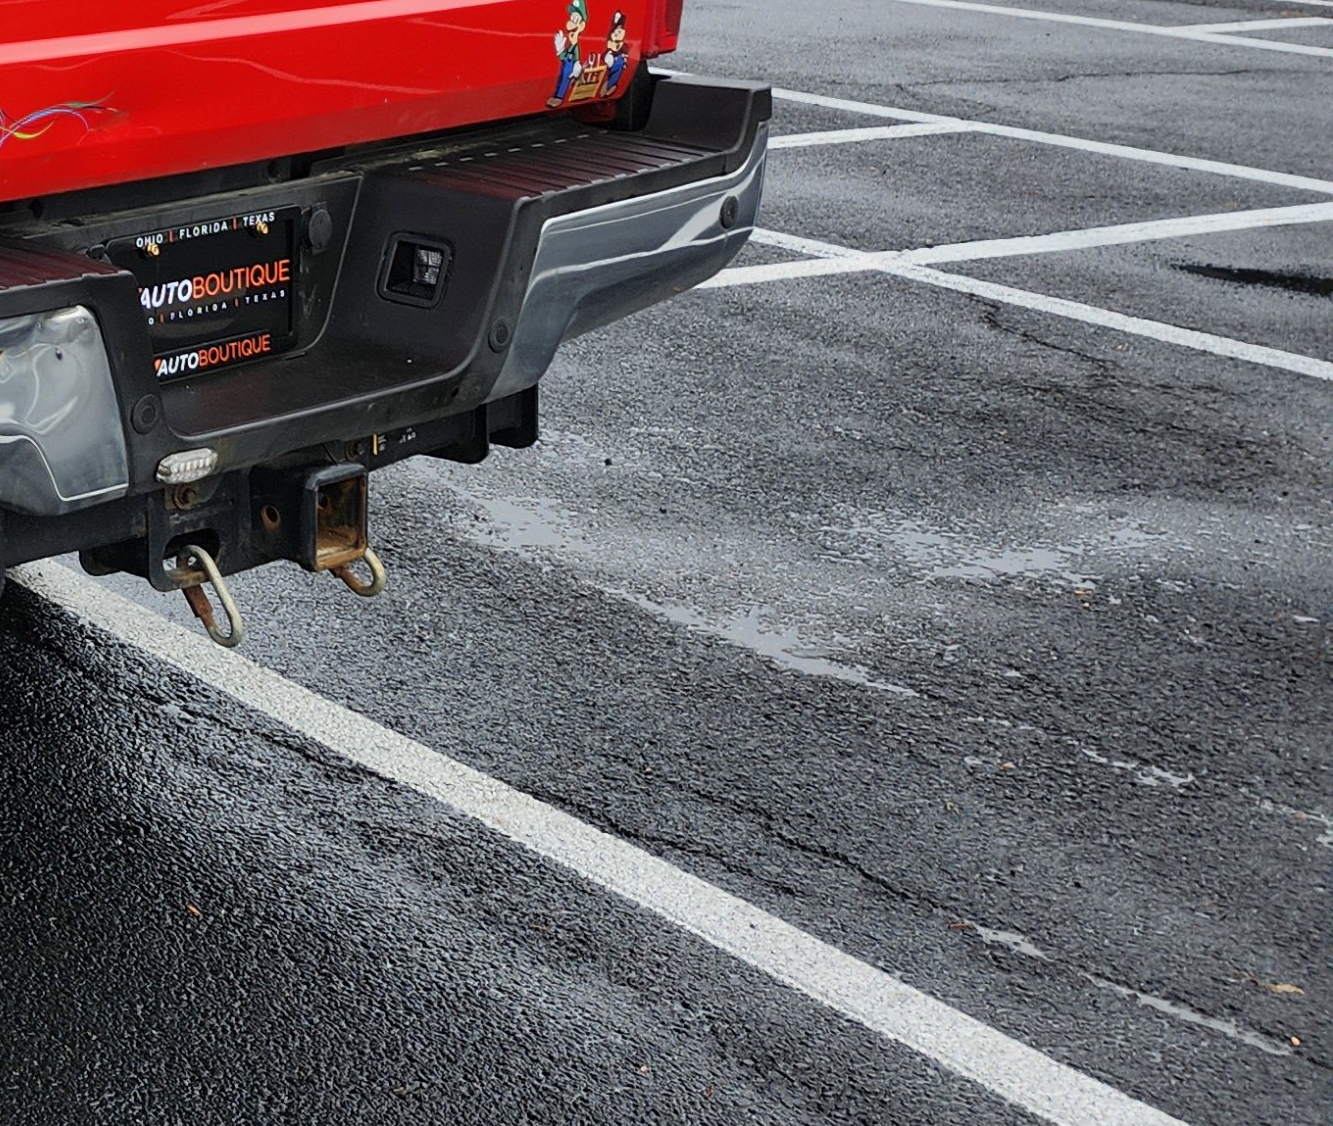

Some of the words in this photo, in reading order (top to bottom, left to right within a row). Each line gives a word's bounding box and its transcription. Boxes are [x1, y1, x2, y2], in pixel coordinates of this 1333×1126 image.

[136, 233, 164, 249] OHIO
[179, 220, 228, 240] FLORIDA
[242, 211, 275, 227] TEXAS
[140, 259, 291, 310] AUTOBOUTIQUE
[170, 301, 228, 320] FLORIDA
[245, 289, 285, 304] TEXAS
[156, 333, 272, 377] AUTOBOUTIQUE
